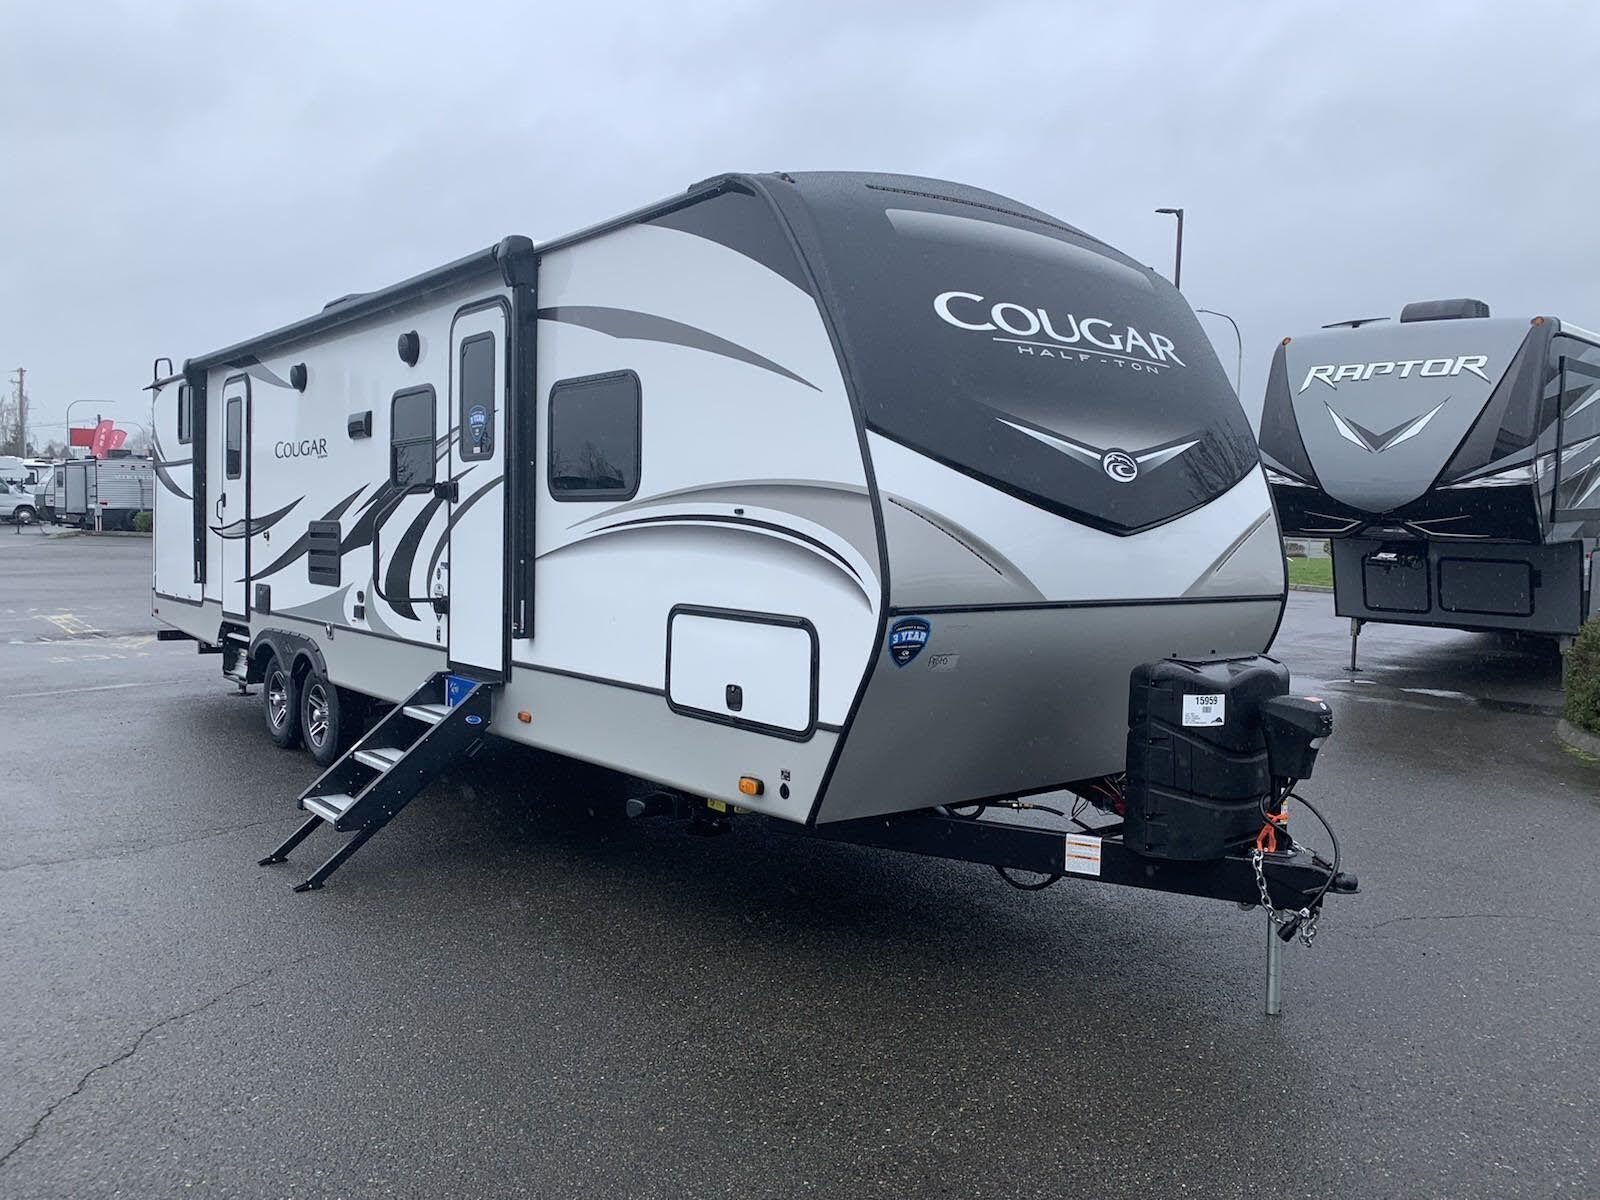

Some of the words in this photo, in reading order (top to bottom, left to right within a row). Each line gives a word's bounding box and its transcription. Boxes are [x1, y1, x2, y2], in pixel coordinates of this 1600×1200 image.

[933, 291, 1186, 368] COUGAR
[1017, 345, 1160, 375] HALF-TON
[1298, 355, 1492, 396] RAPTOR
[274, 438, 328, 459] COUGAR
[892, 634, 899, 644] 3
[901, 631, 927, 642] YEAR
[1195, 696, 1218, 705] 15959
